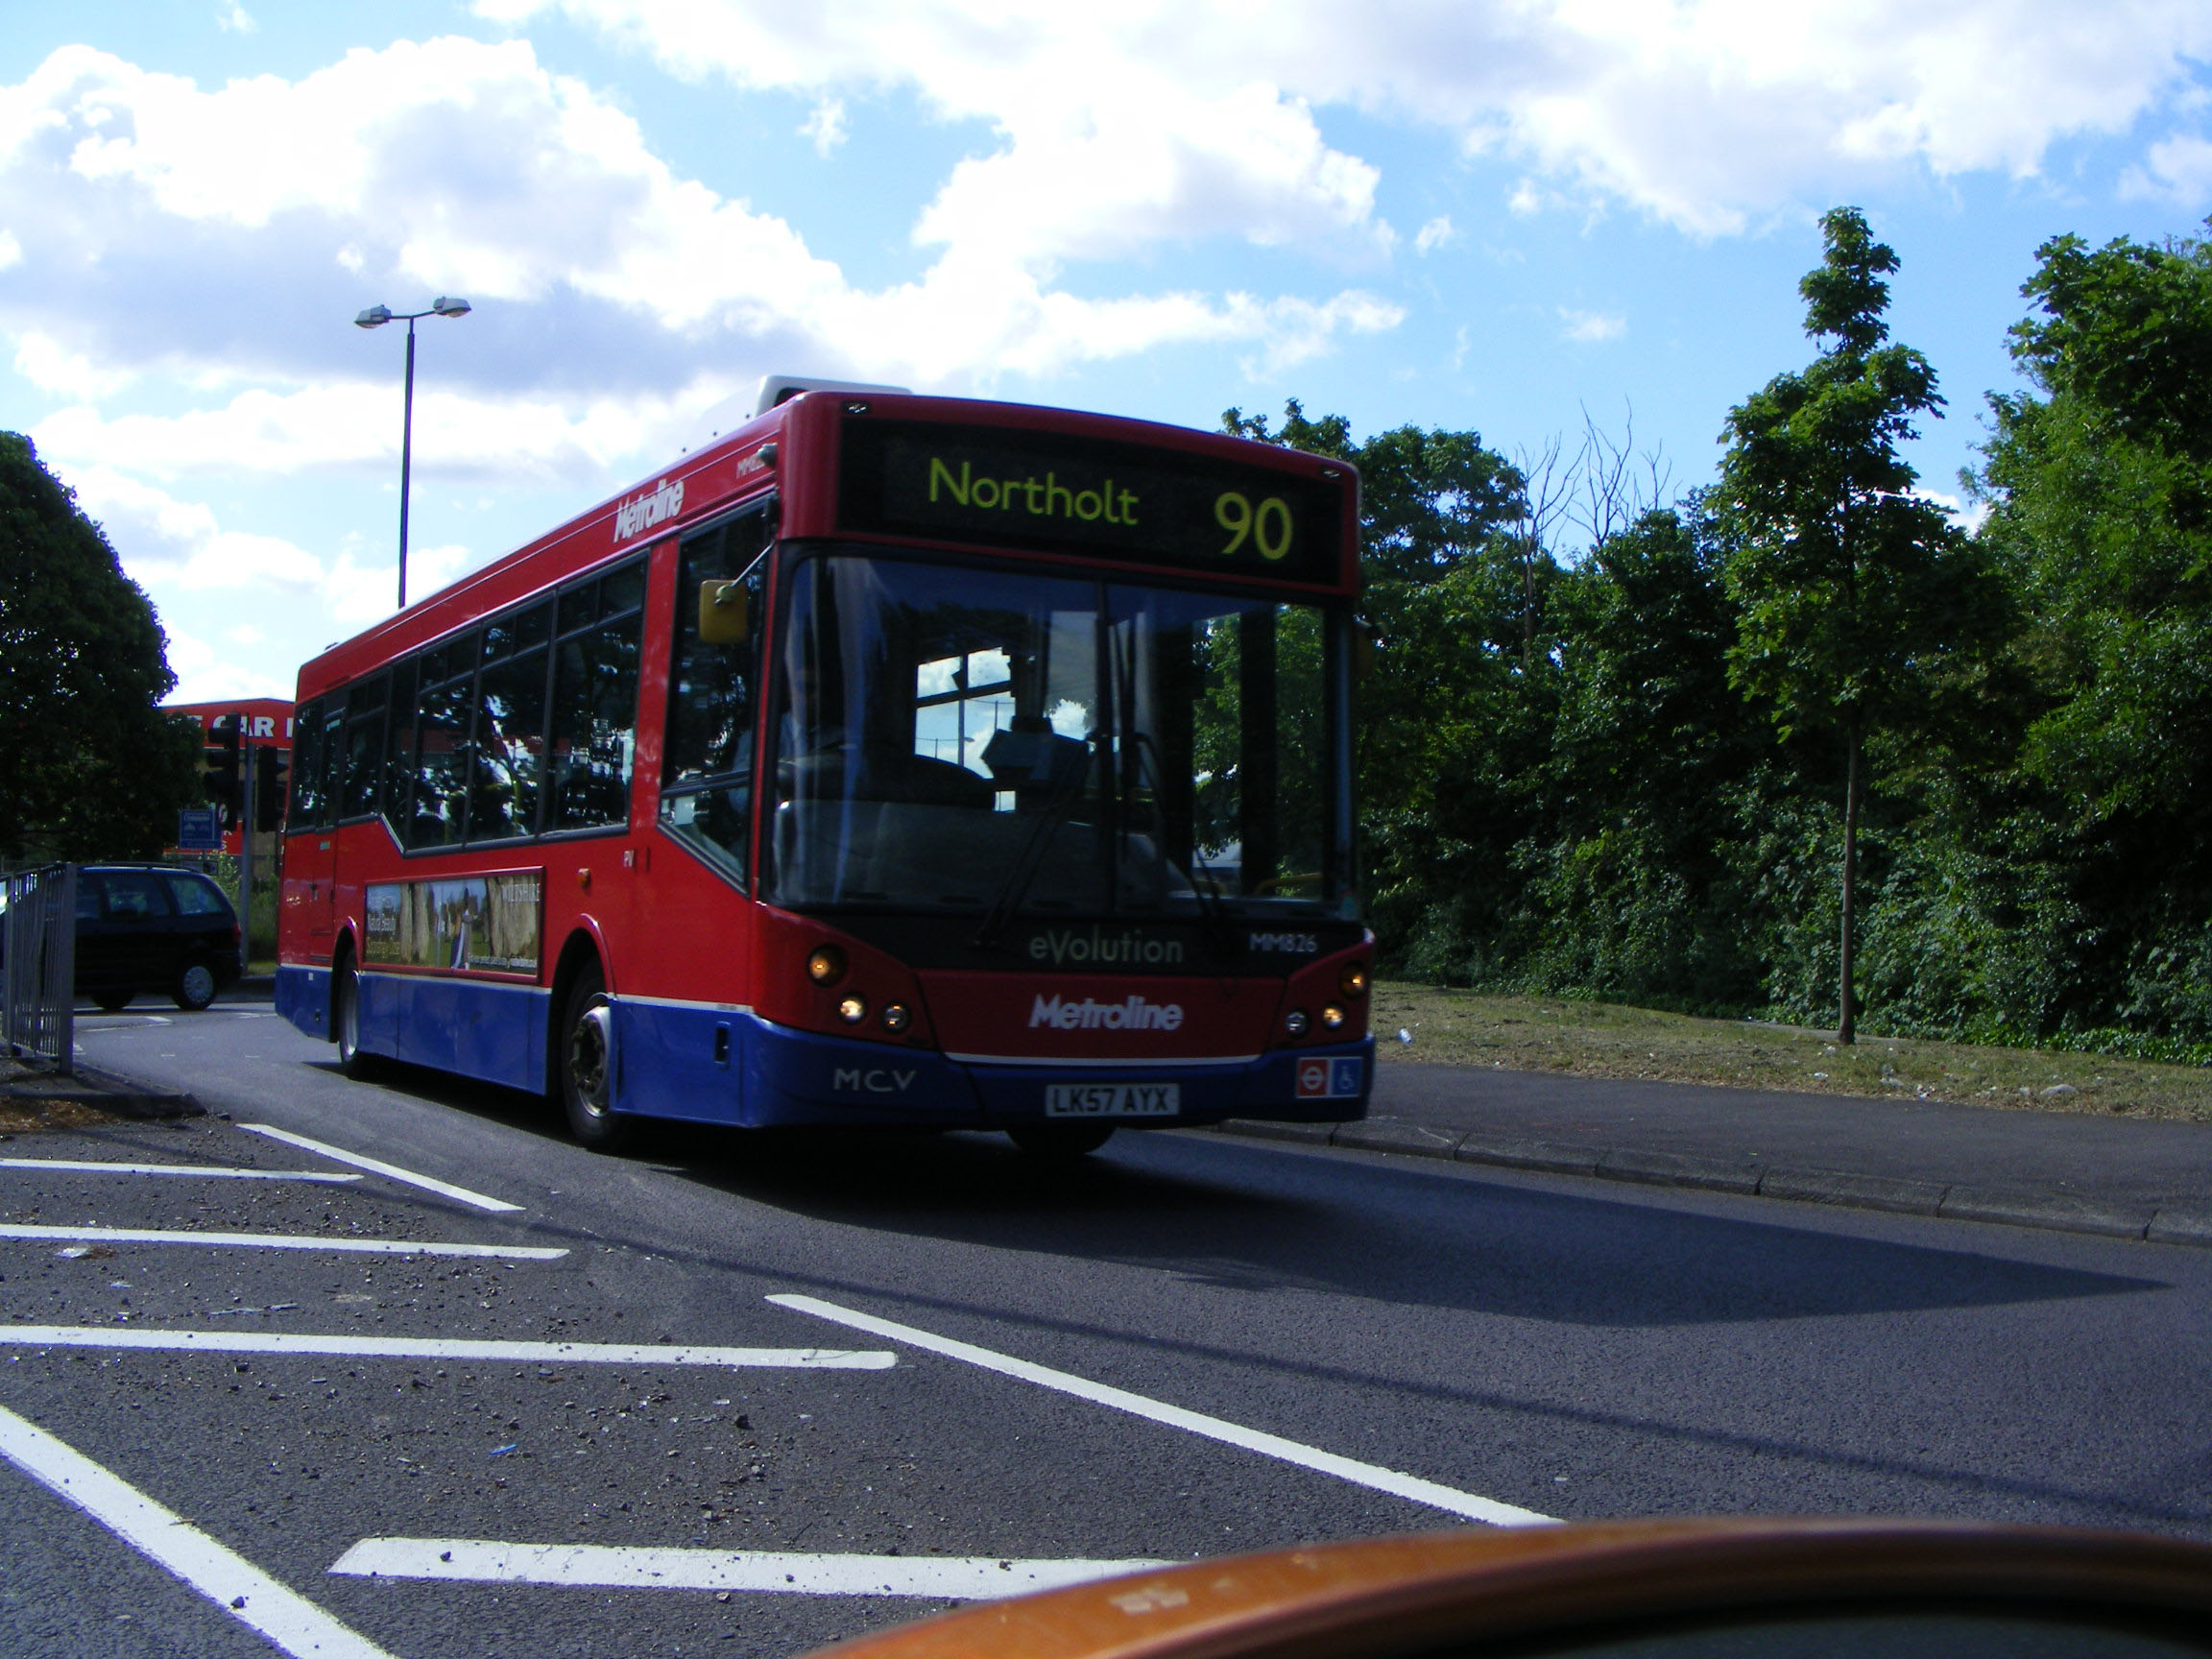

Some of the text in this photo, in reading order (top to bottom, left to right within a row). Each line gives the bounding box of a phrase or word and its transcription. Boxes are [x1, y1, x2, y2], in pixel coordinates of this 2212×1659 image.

[613, 479, 685, 544] Metroline
[928, 456, 1293, 561] Northolt 90
[1029, 925, 1184, 966] eVolution
[1250, 932, 1318, 953] MM826
[1028, 993, 1185, 1031] Metroline
[832, 1068, 917, 1093] MCV
[1052, 1086, 1170, 1114] LK57 AYX
